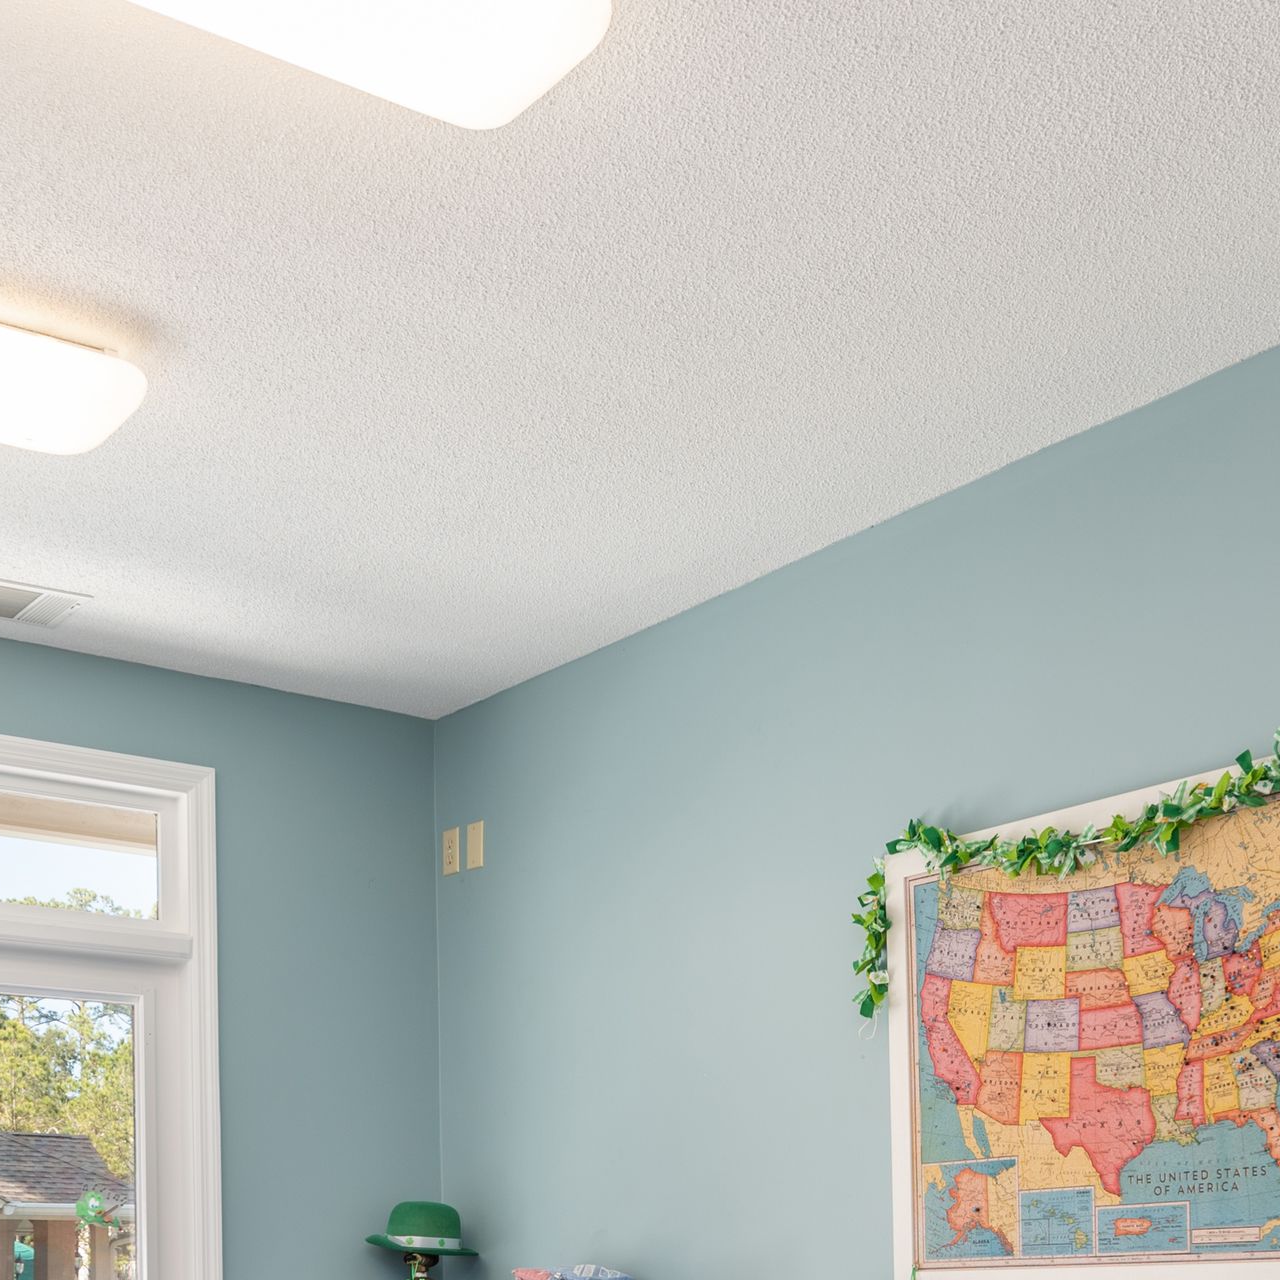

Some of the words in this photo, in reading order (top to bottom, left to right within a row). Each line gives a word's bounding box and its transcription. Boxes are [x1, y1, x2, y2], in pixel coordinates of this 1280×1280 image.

[953, 1006, 987, 1016] NEVADA
[1024, 1087, 1066, 1095] MEXICO
[1064, 1119, 1141, 1129] TEXAS
[1128, 1174, 1152, 1184] THE
[1159, 1169, 1209, 1183] UNITED
[1217, 1165, 1267, 1179] STATES
[1154, 1186, 1170, 1196] OF
[1177, 1182, 1239, 1195] AMERICA
